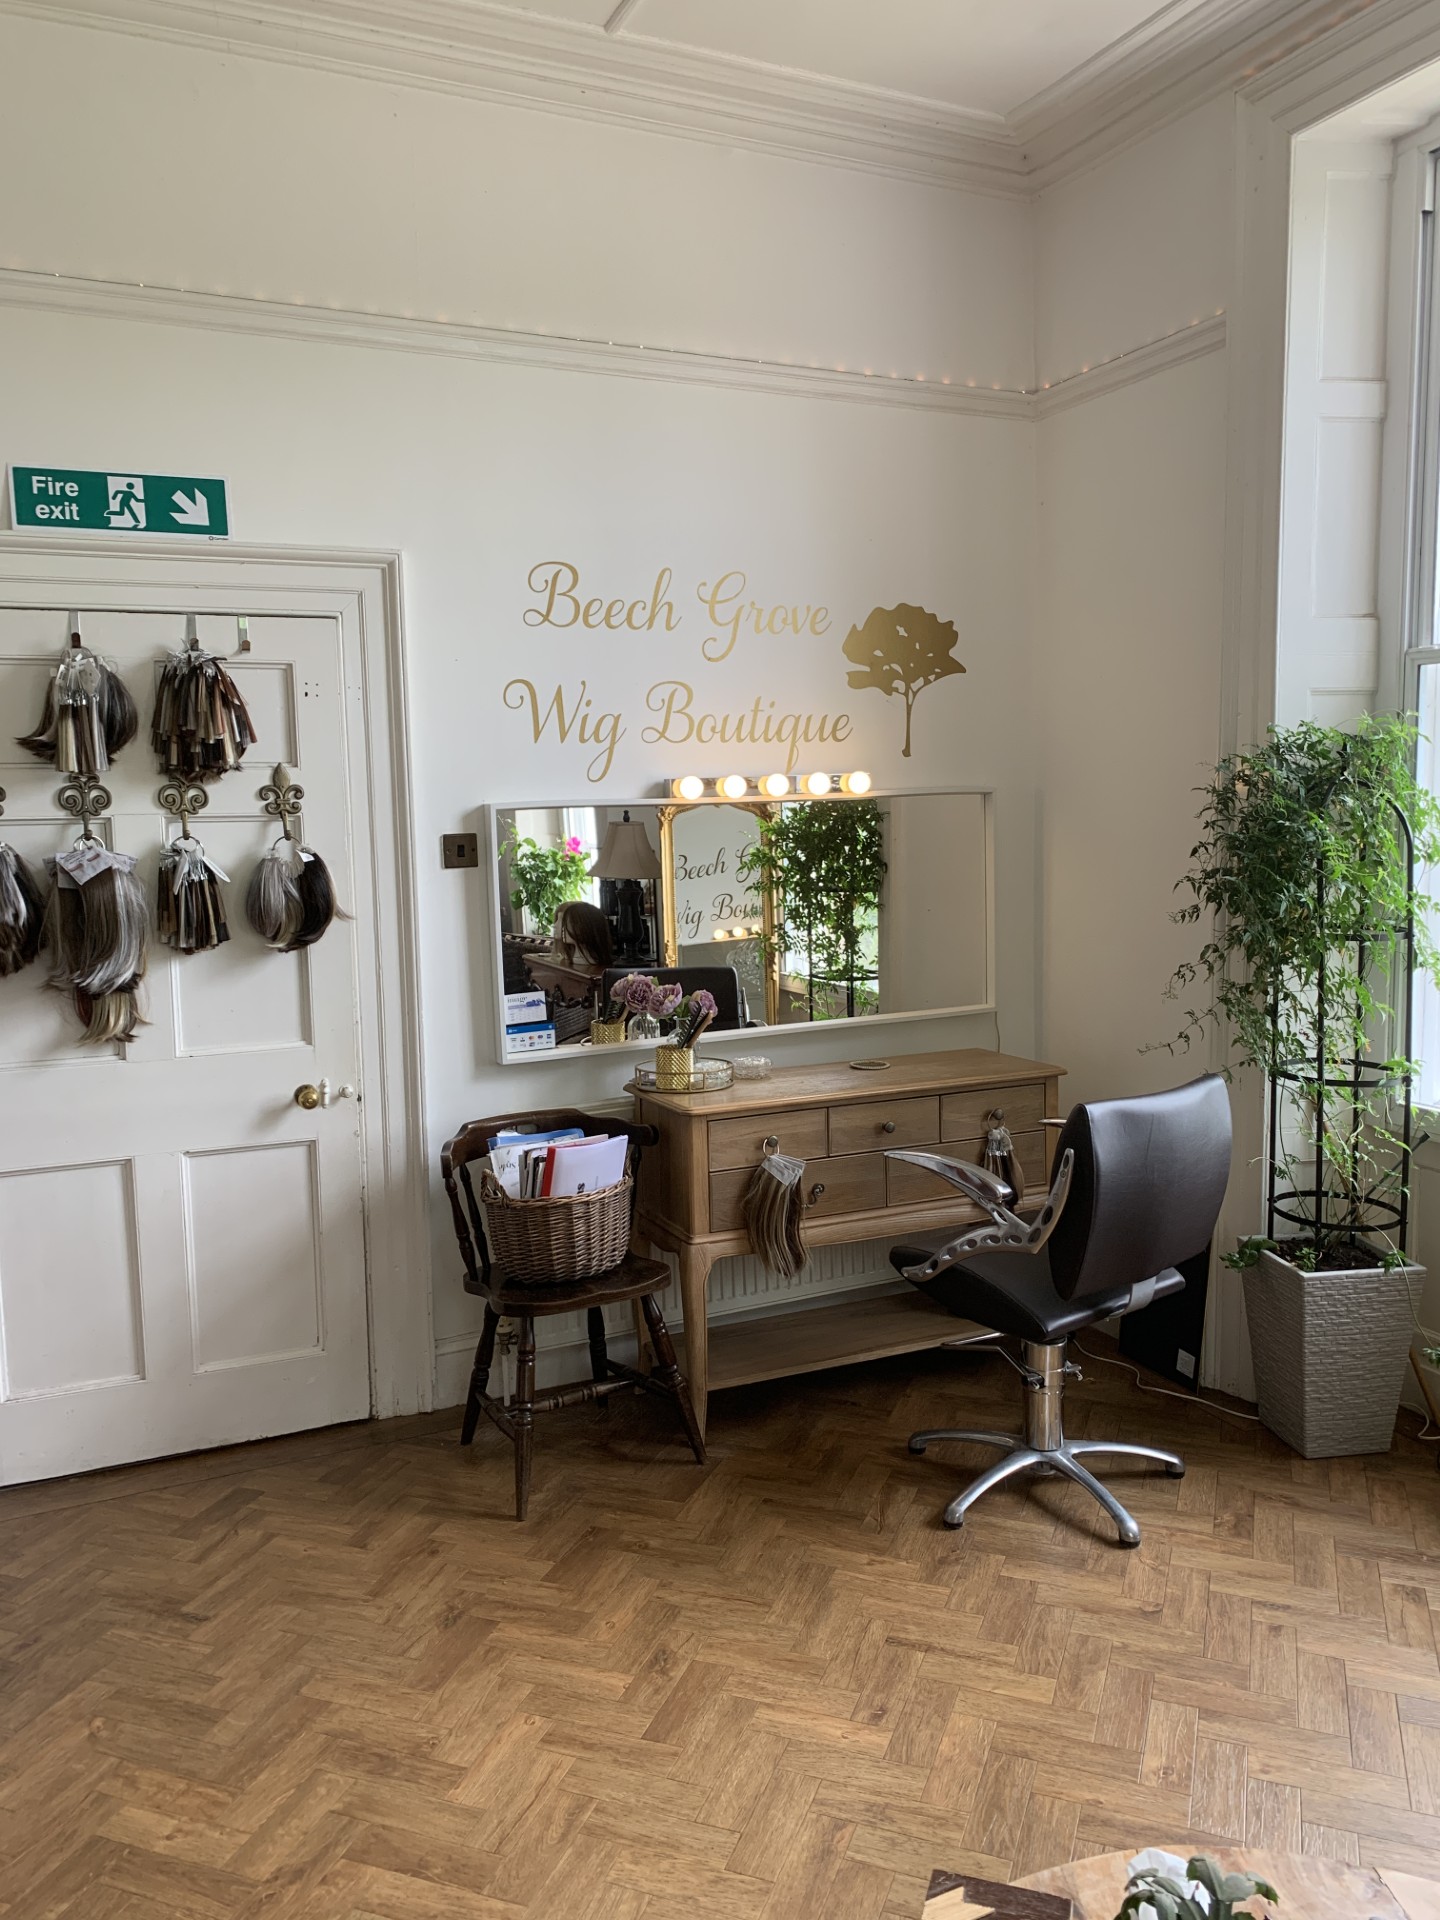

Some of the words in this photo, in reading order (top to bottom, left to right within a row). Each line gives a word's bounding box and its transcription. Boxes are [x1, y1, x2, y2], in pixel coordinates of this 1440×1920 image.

[31, 475, 79, 497] Fire
[35, 501, 81, 521] exit
[522, 560, 682, 632] Beech
[696, 570, 833, 663] Grove
[502, 678, 627, 784] Wig
[640, 680, 854, 775] Boutique
